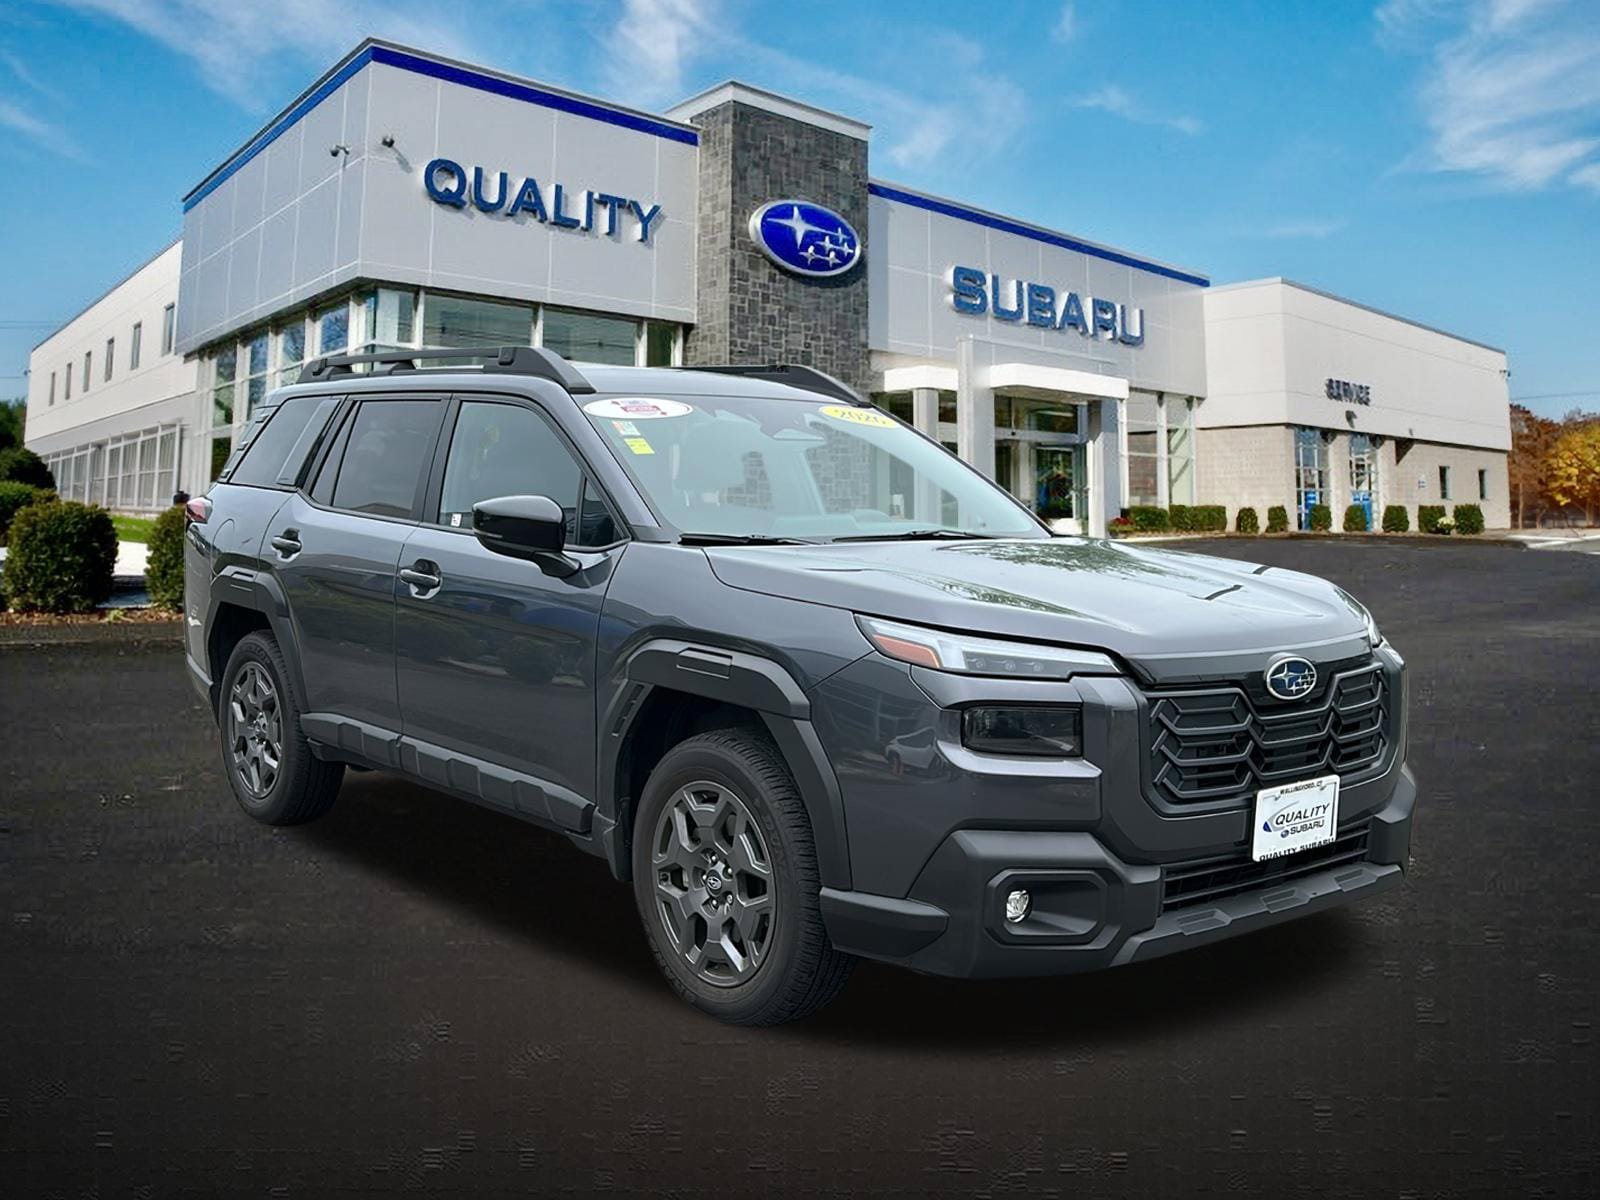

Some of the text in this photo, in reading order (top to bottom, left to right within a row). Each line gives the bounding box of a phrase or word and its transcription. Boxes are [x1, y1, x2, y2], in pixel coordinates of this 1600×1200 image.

[424, 158, 662, 243] QUALITY
[948, 265, 1145, 347] SUBARU
[1275, 803, 1330, 826] QUALITY
[1290, 820, 1325, 835] SUBARU
